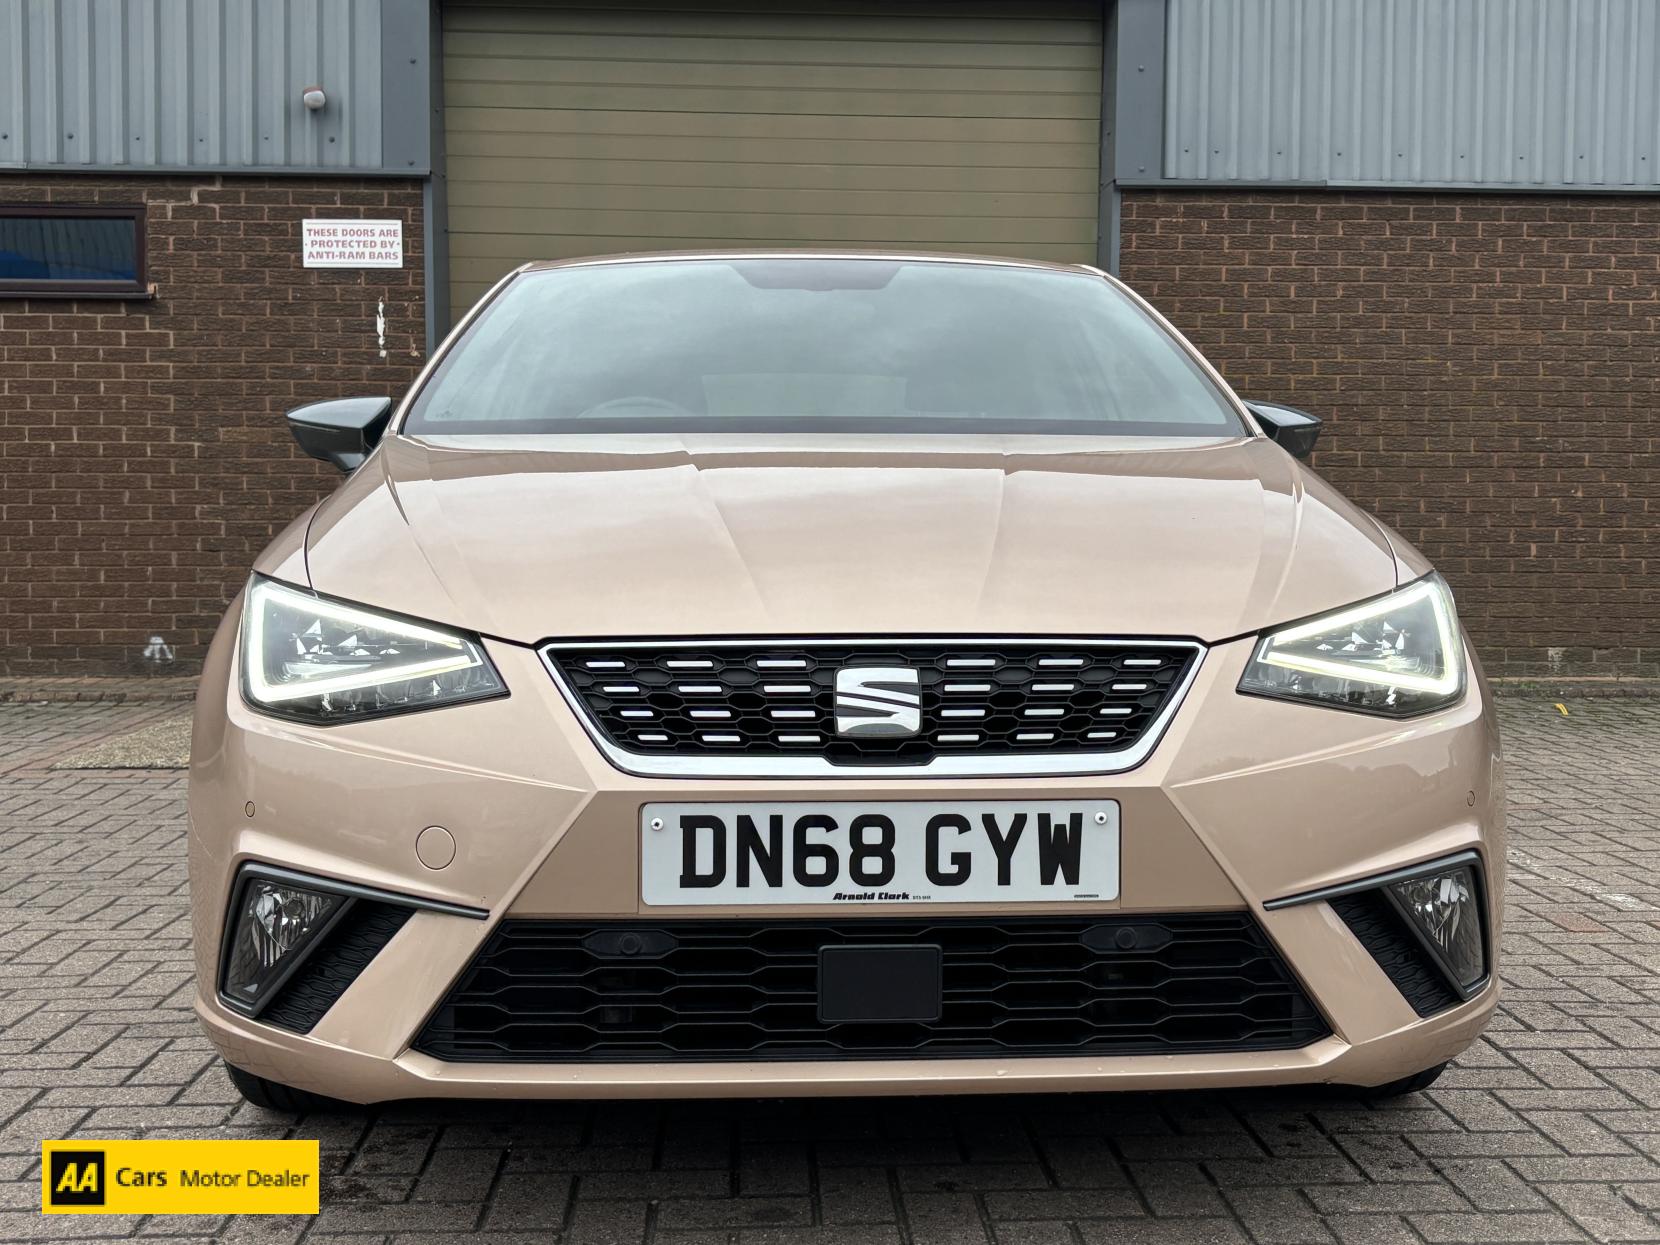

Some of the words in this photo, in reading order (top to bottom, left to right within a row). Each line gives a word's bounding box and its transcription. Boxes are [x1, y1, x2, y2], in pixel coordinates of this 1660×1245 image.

[307, 228, 338, 237] THESE
[341, 228, 376, 238] DOORS
[379, 229, 399, 238] ARE
[310, 239, 377, 249] PROTECTED
[380, 240, 395, 249] BY
[307, 250, 366, 260] ANTI-RAM
[368, 251, 399, 261] BARS
[679, 813, 896, 888] DN68
[925, 812, 1084, 887] GYW
[833, 892, 875, 900] Arnold
[877, 892, 910, 900] Clark
